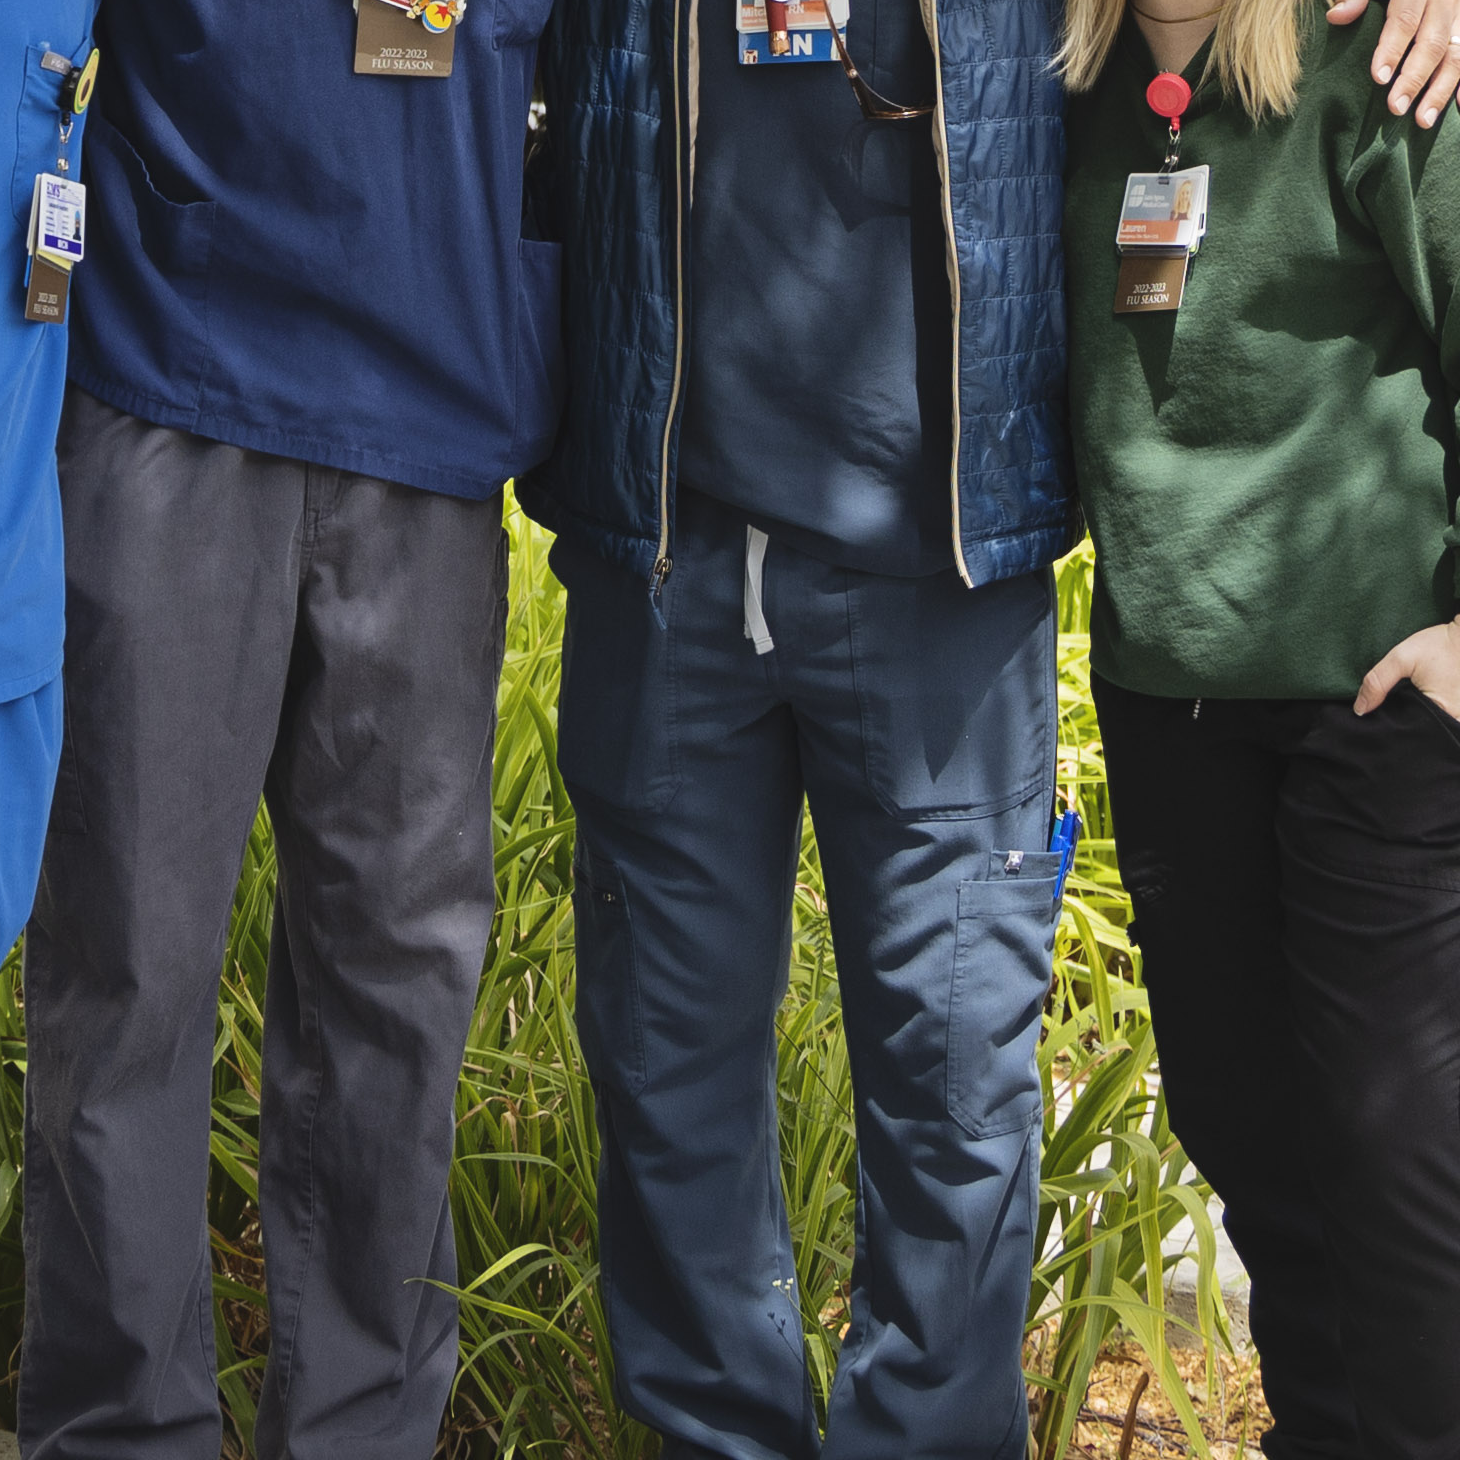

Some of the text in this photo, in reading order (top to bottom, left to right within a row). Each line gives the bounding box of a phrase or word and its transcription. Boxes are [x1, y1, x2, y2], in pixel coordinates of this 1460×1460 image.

[788, 4, 804, 14] RN
[380, 47, 428, 60] 2022-2023
[371, 59, 434, 71] FLU SEASON
[1132, 282, 1167, 294] 2022-2023
[1126, 293, 1170, 306] FLU SEASON
